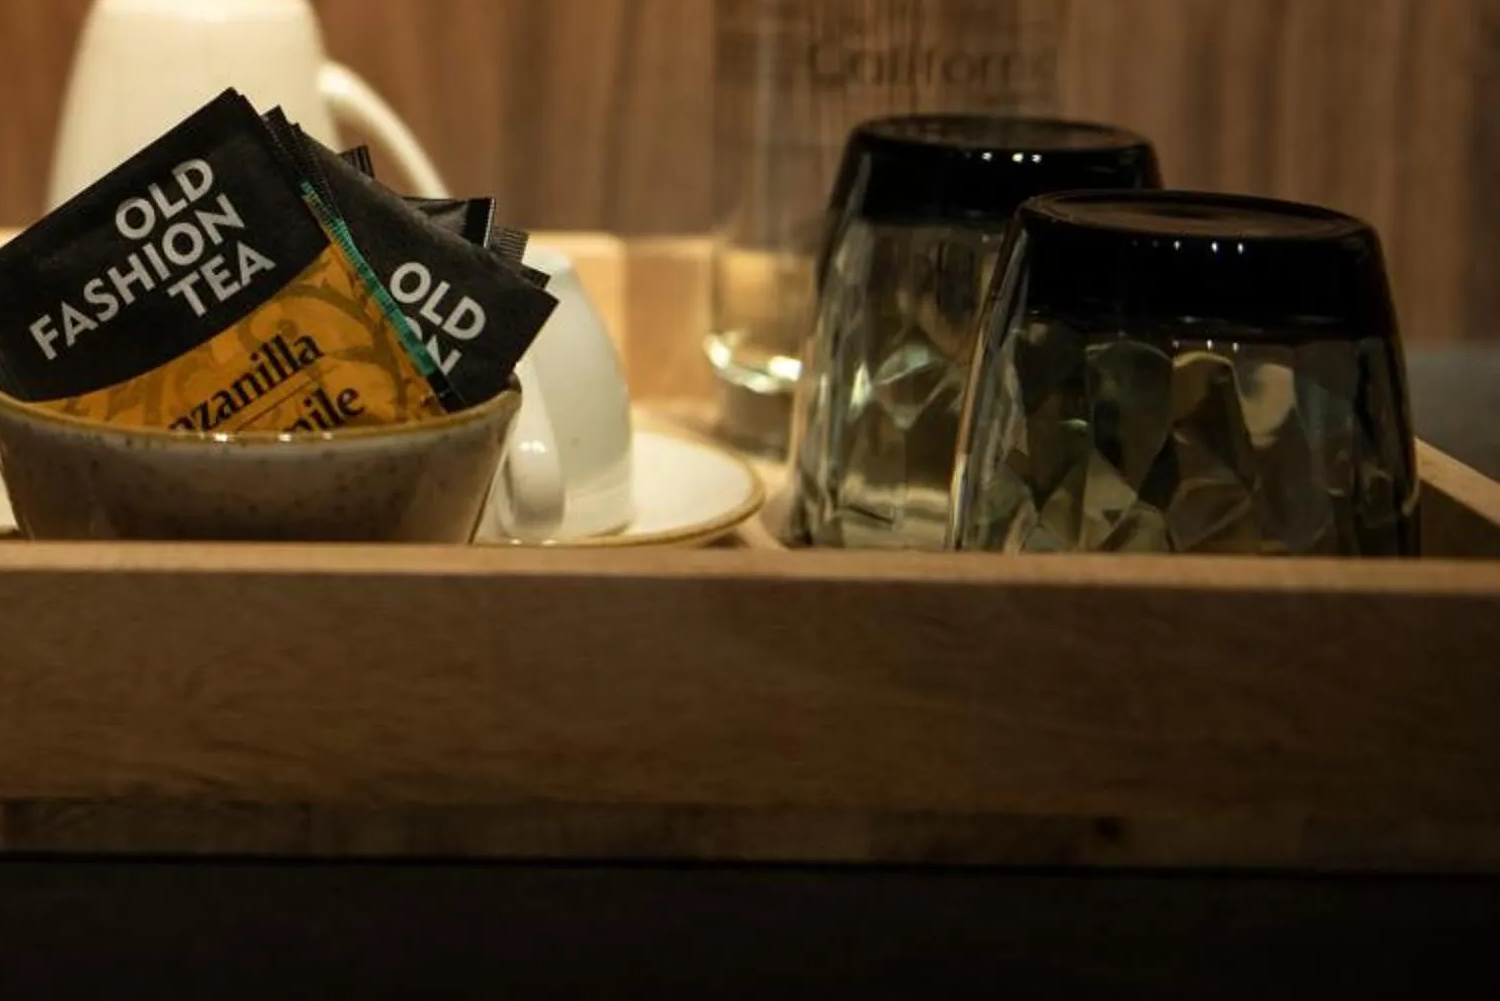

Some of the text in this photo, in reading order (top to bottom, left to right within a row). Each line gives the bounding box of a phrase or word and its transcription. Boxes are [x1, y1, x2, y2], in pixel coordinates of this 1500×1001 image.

[115, 158, 215, 240] OLD
[28, 192, 245, 360] FASHION
[166, 240, 277, 318] TEA
[389, 261, 487, 340] OLD
